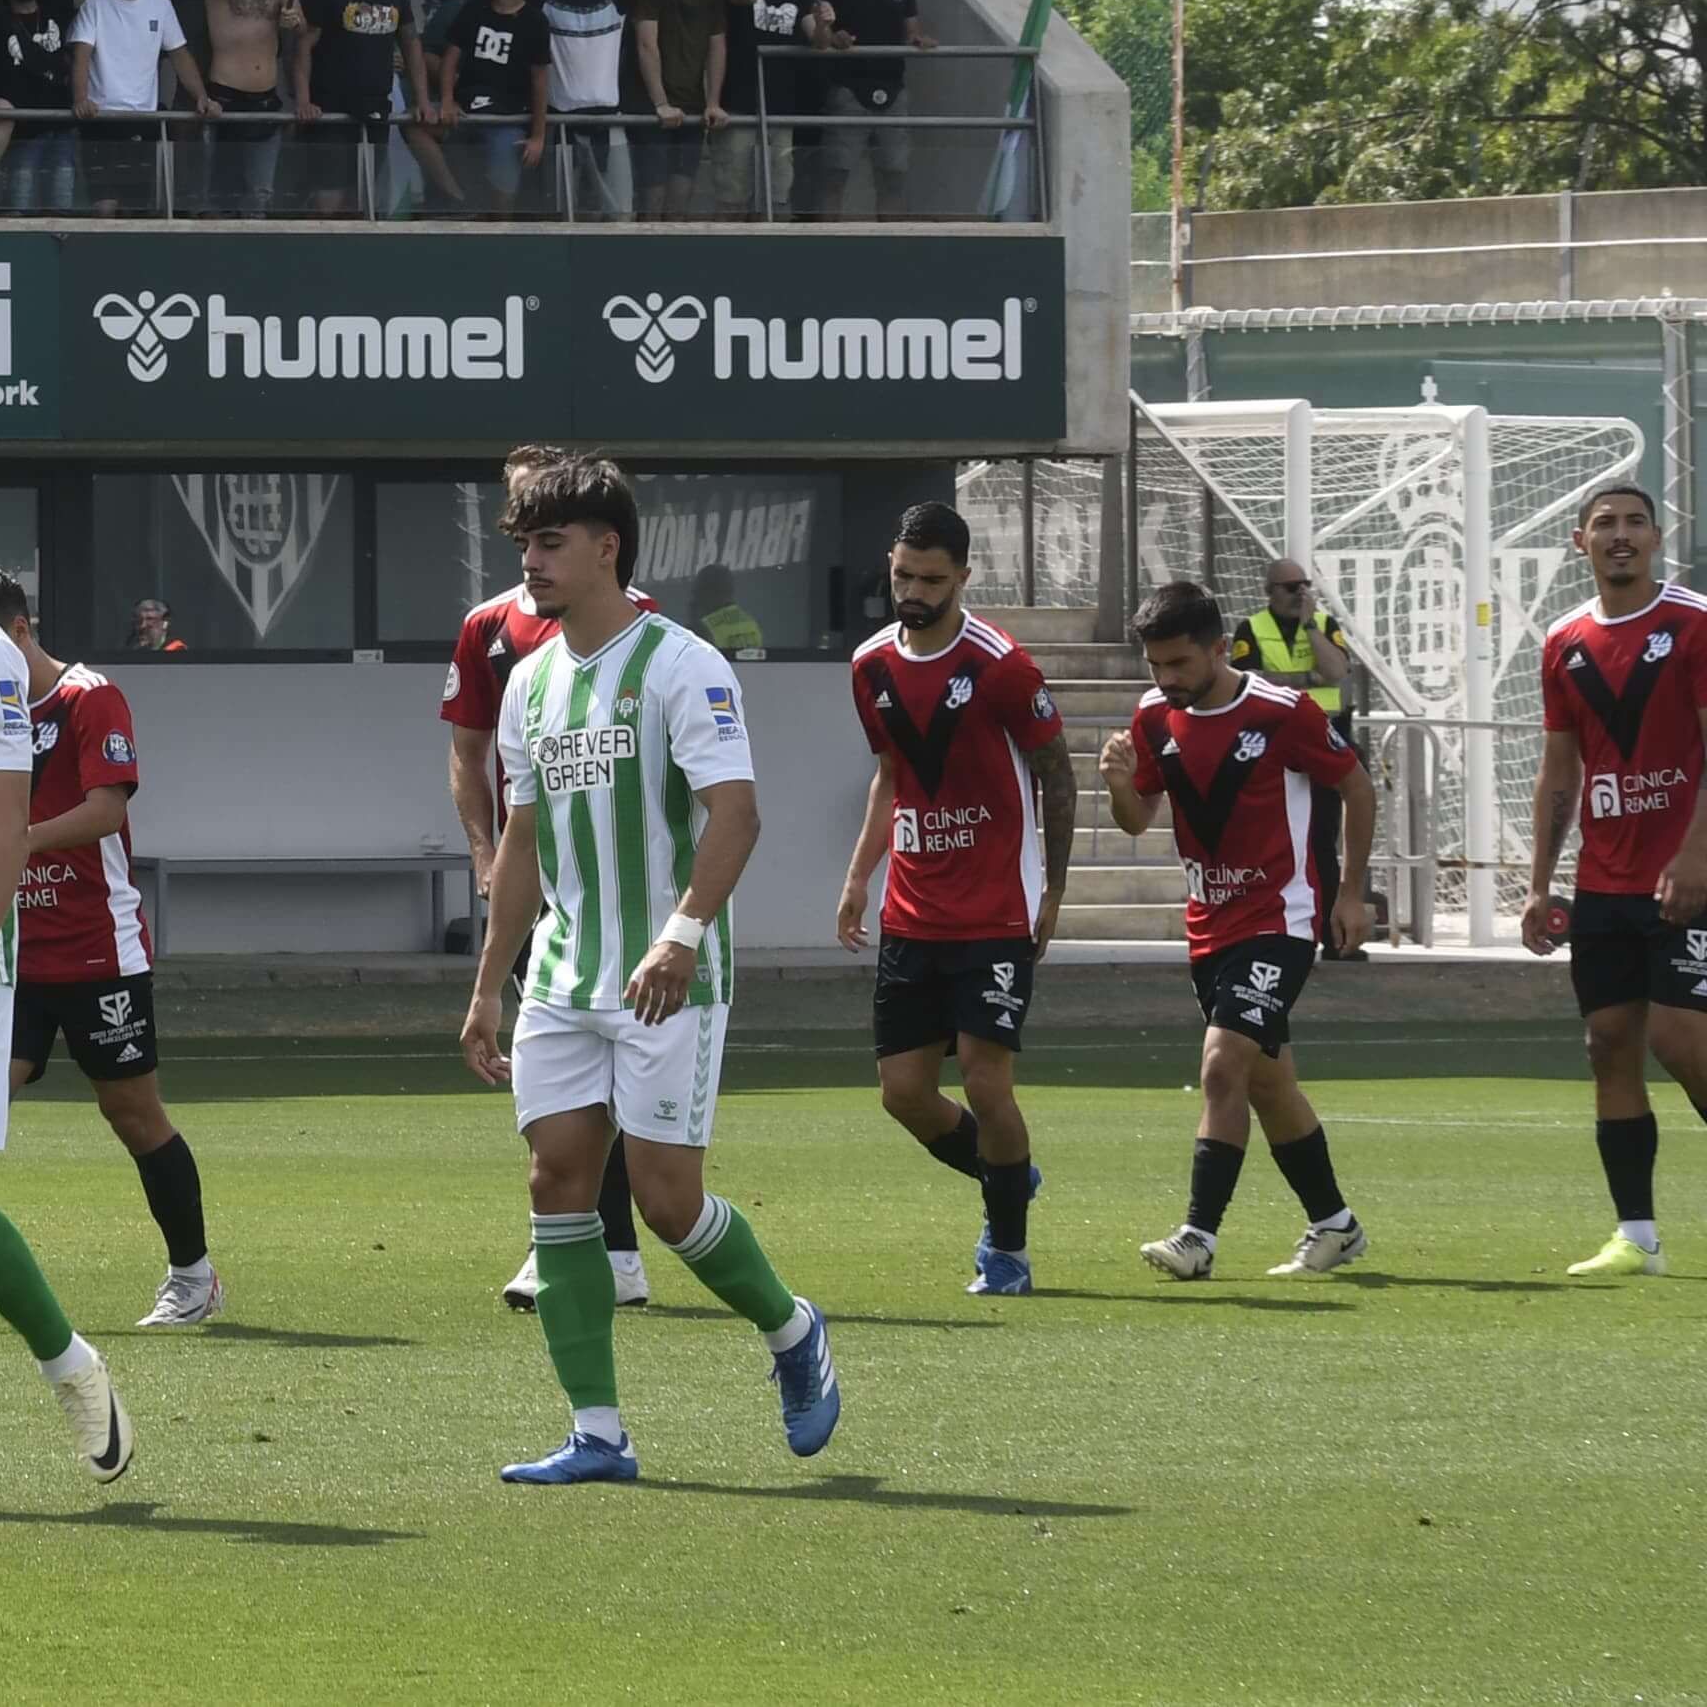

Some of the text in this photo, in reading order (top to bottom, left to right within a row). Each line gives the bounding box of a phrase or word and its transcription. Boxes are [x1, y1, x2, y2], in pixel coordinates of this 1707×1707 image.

[208, 294, 524, 379] hummel
[714, 296, 1022, 381] hummel
[530, 728, 632, 763] FOREVER
[545, 759, 611, 791] GREEN
[923, 804, 992, 830] CLÍNICA
[1624, 792, 1670, 814] REMEI
[925, 829, 975, 853] REMEI
[1204, 862, 1267, 885] CLÍNICA
[97, 989, 133, 1027] SP
